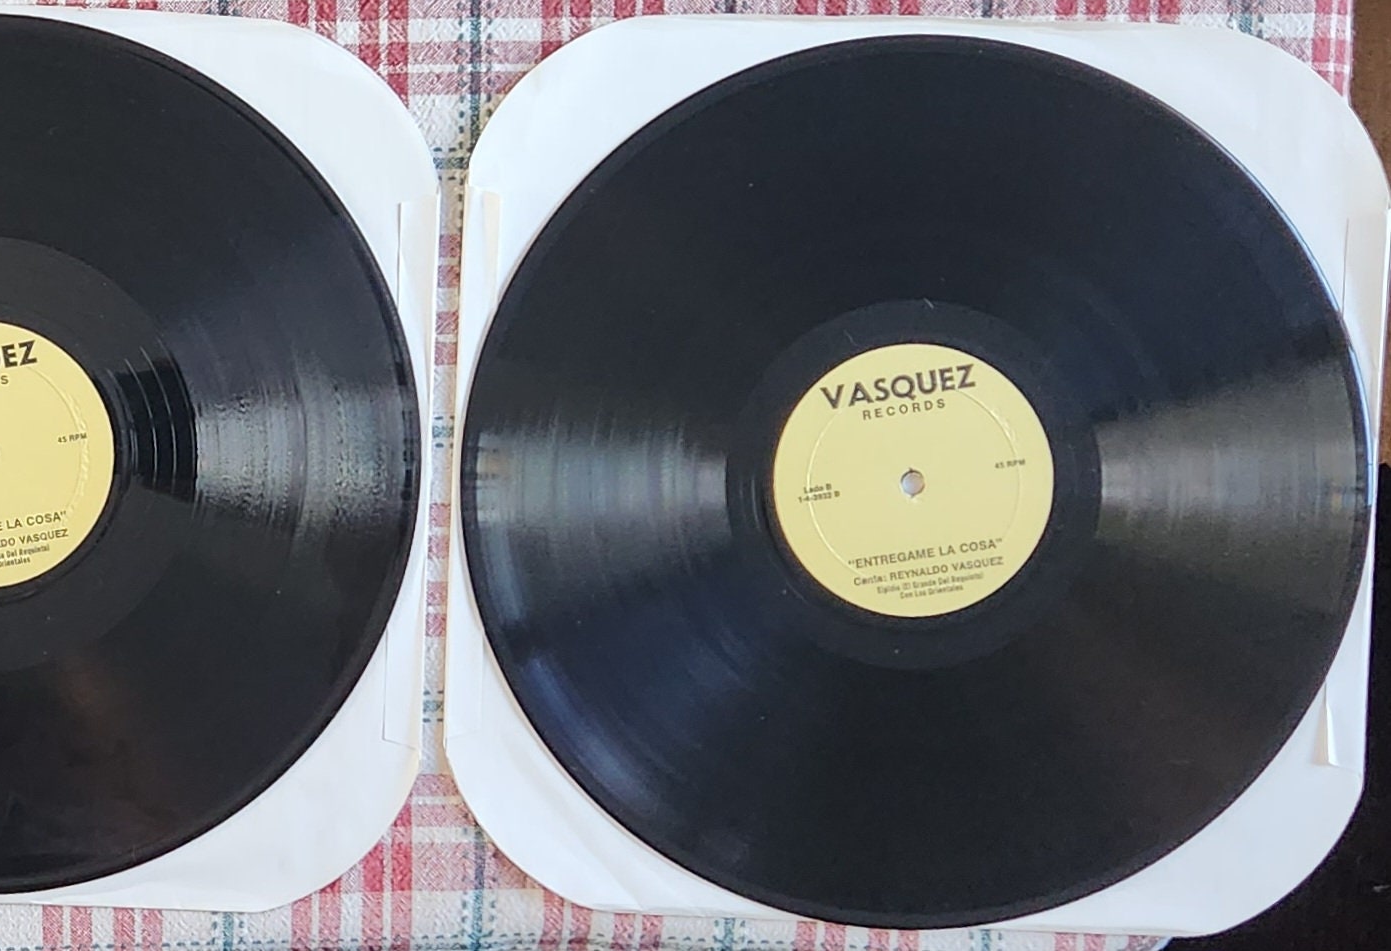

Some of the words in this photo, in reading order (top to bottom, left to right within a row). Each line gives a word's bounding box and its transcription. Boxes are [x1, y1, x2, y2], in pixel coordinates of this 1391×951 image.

[820, 363, 976, 409] VASQUEZ
[862, 398, 946, 420] RECORDS
[58, 435, 67, 443] 45
[69, 433, 87, 442] RPM
[6, 519, 23, 529] LA
[26, 511, 66, 526] COSA"
[19, 529, 68, 545] VASQUEZ
[848, 548, 935, 569] "ENTREGAME
[939, 545, 956, 556] LA
[960, 538, 1003, 553] COSA"
[854, 575, 887, 586] Canta:
[890, 565, 948, 581] REYNALDO
[952, 556, 1004, 571] VASQUEZ
